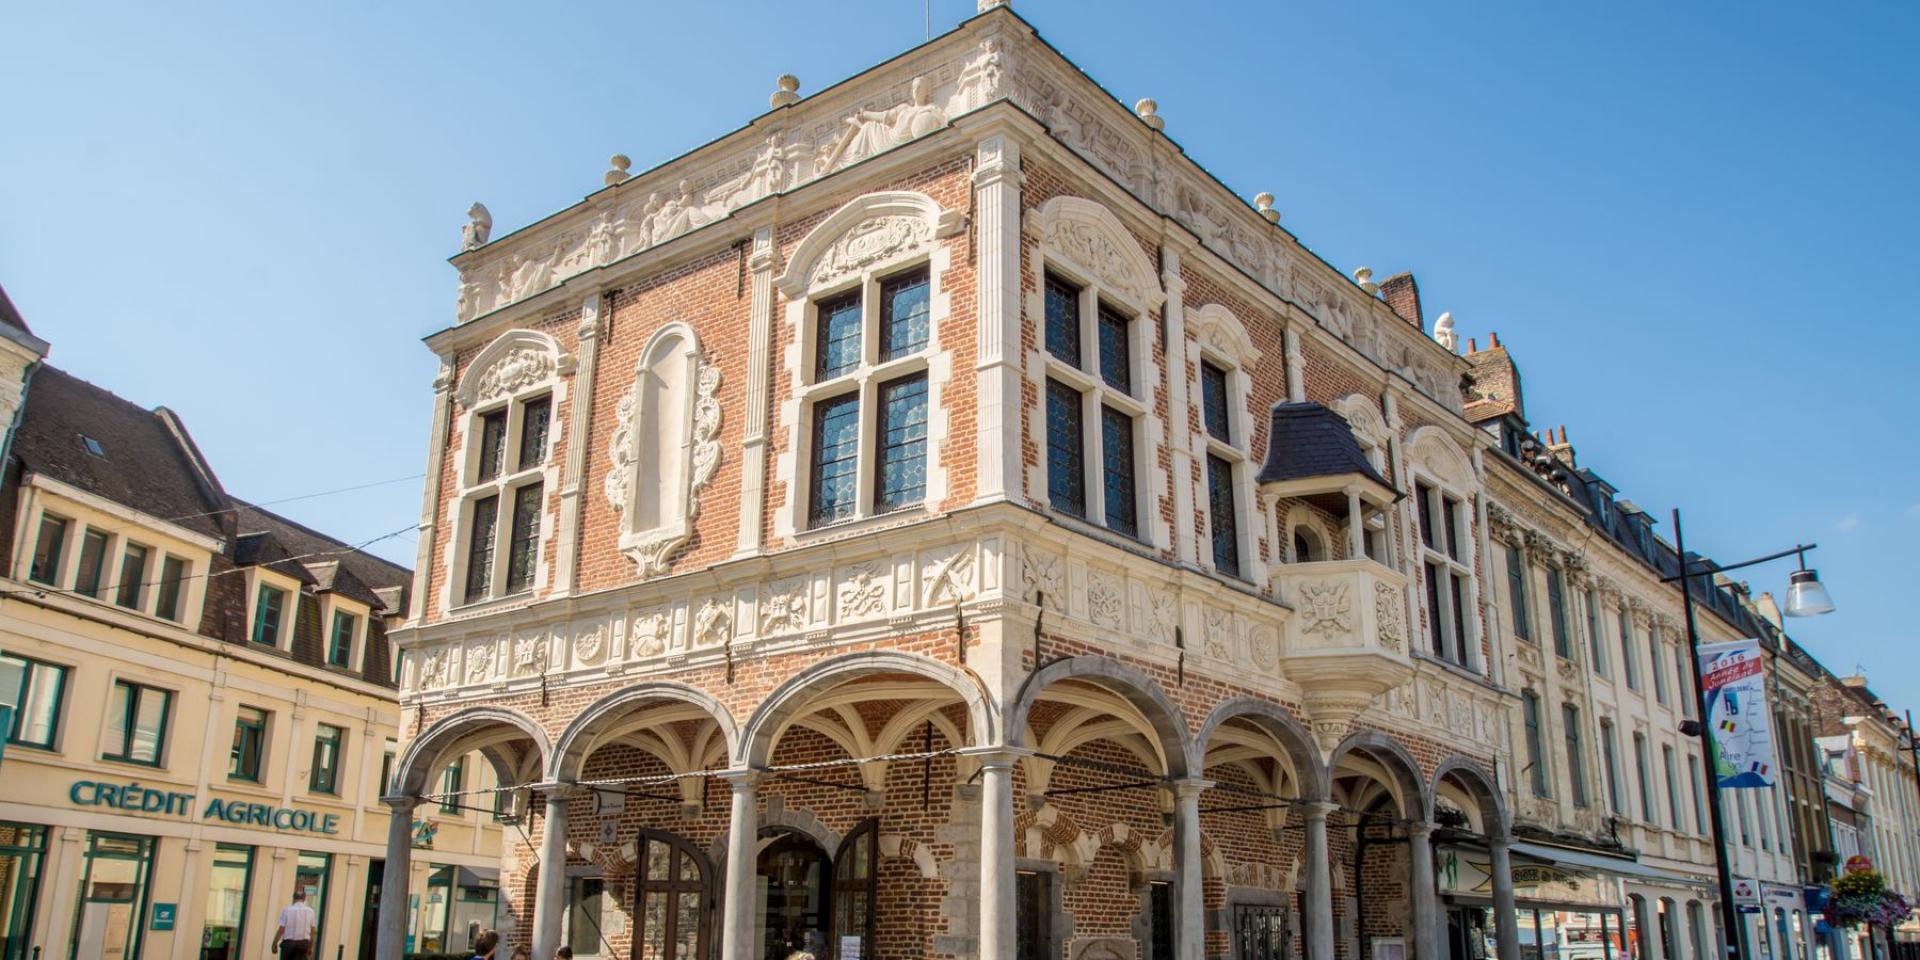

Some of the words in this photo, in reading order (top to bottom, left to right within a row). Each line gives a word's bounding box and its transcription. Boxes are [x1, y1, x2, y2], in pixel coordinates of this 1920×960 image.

[1711, 653, 1745, 671] 2016
[69, 780, 196, 816] CRÉDIT
[204, 798, 340, 835] AGRICOLE
